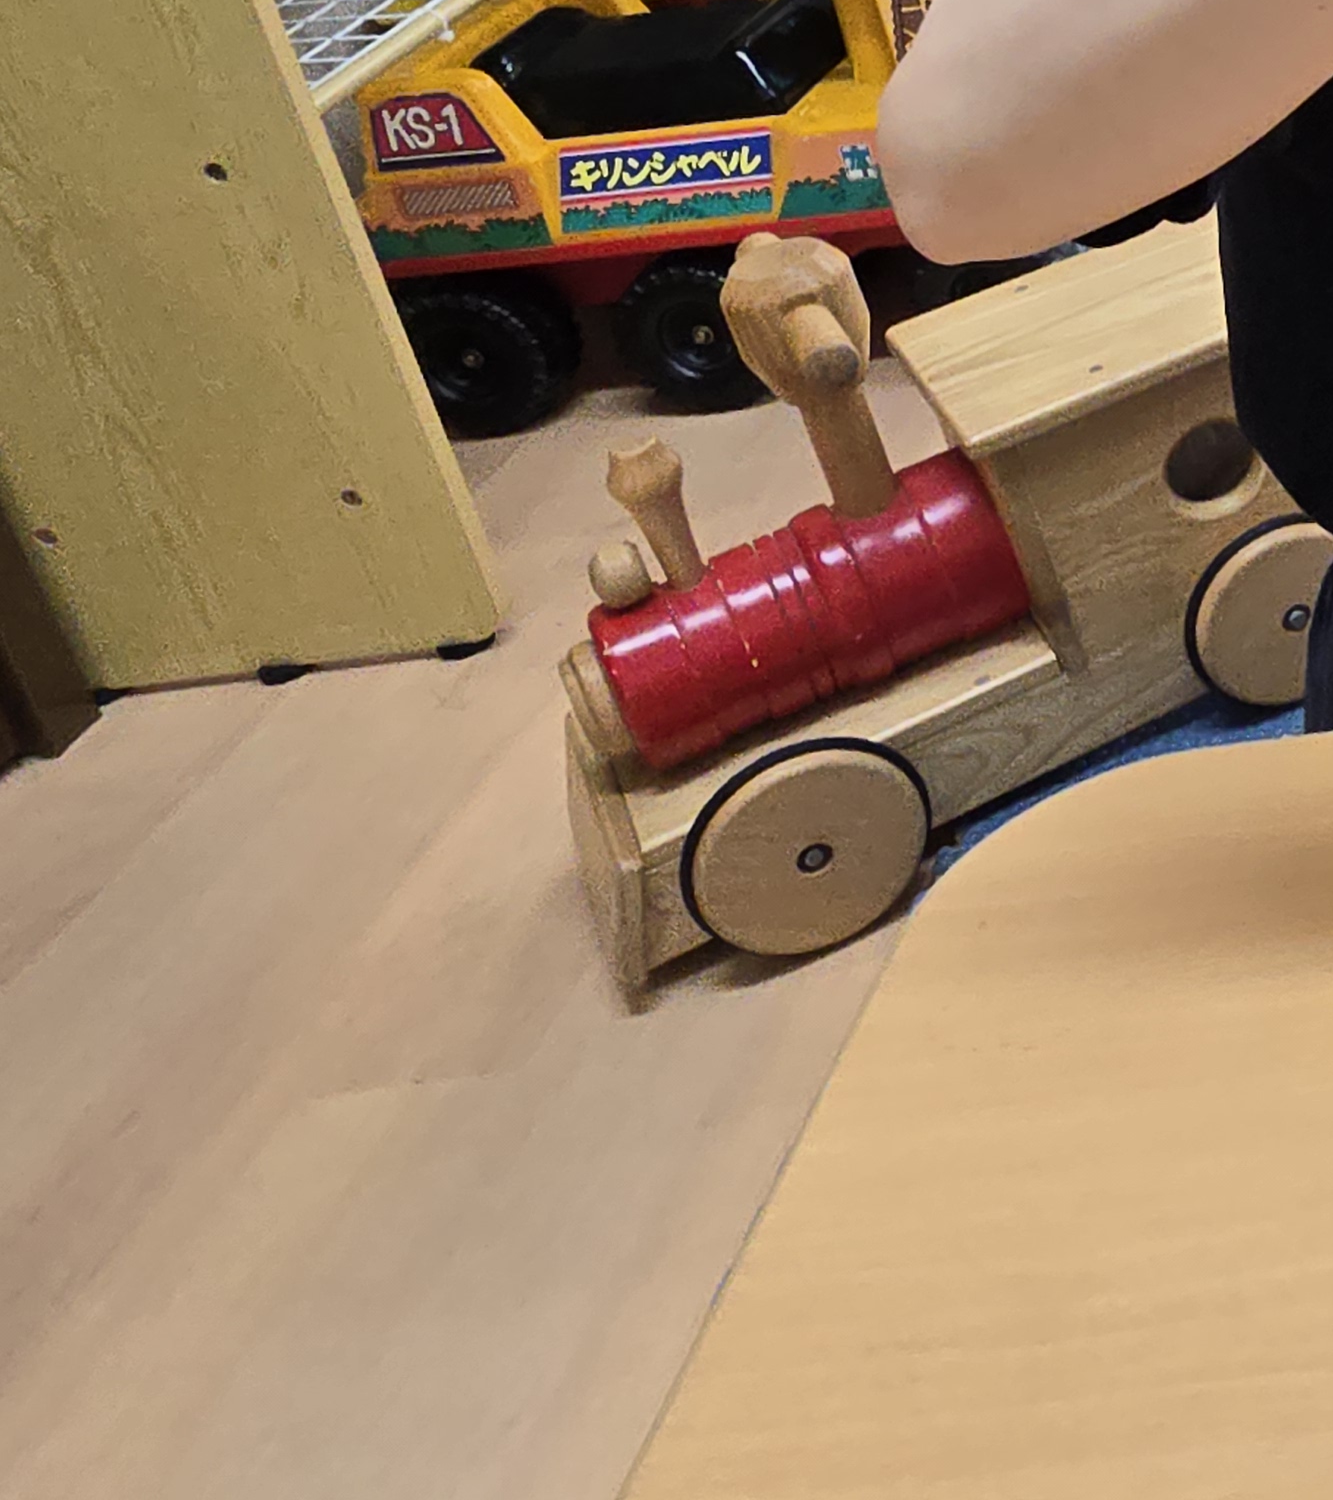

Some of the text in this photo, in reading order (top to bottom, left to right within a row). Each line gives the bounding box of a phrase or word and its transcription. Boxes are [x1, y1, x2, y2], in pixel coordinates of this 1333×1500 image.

[381, 103, 464, 152] KS-1
[570, 145, 762, 192] キリンシャベル
